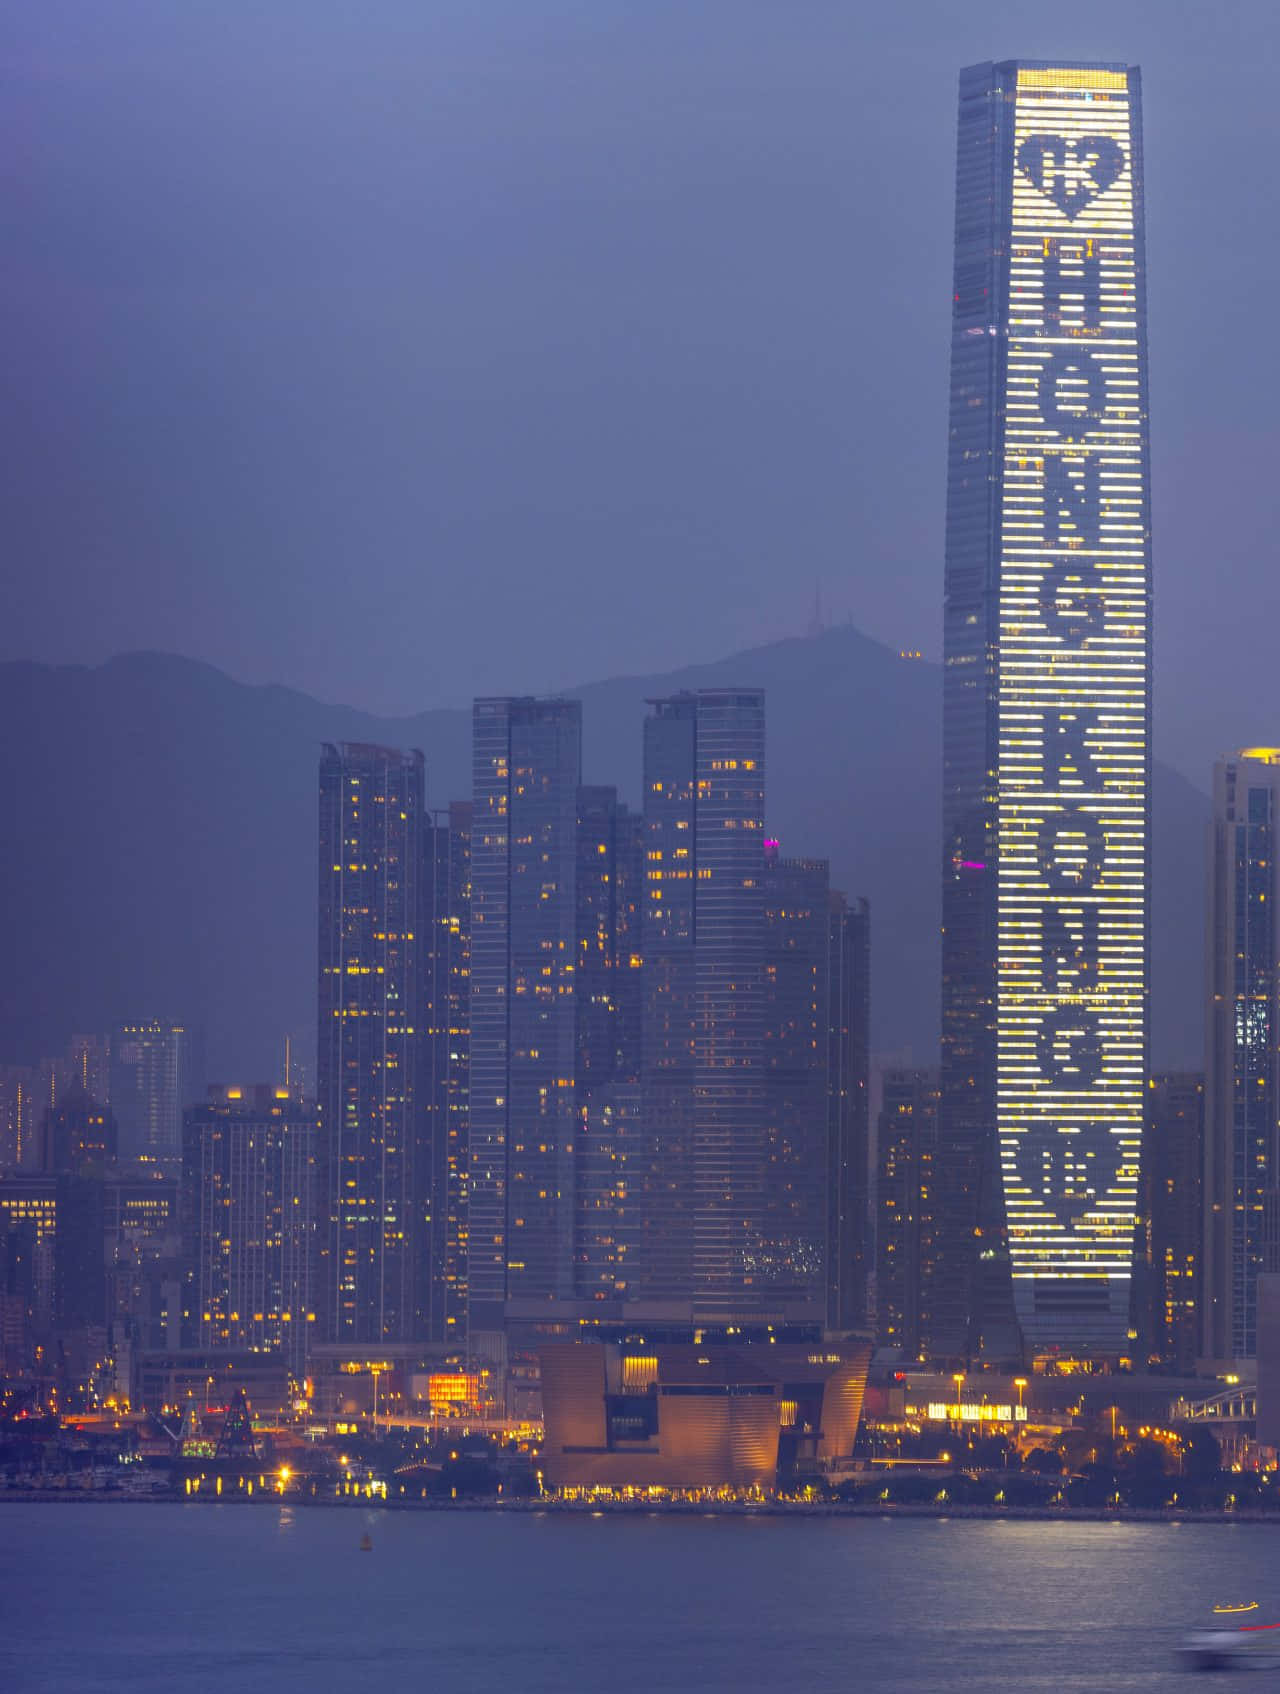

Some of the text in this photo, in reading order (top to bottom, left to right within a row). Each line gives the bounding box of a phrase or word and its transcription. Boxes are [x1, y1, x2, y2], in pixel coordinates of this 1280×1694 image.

[1042, 151, 1100, 196] HK
[1036, 242, 1106, 1087] HONG KONG
